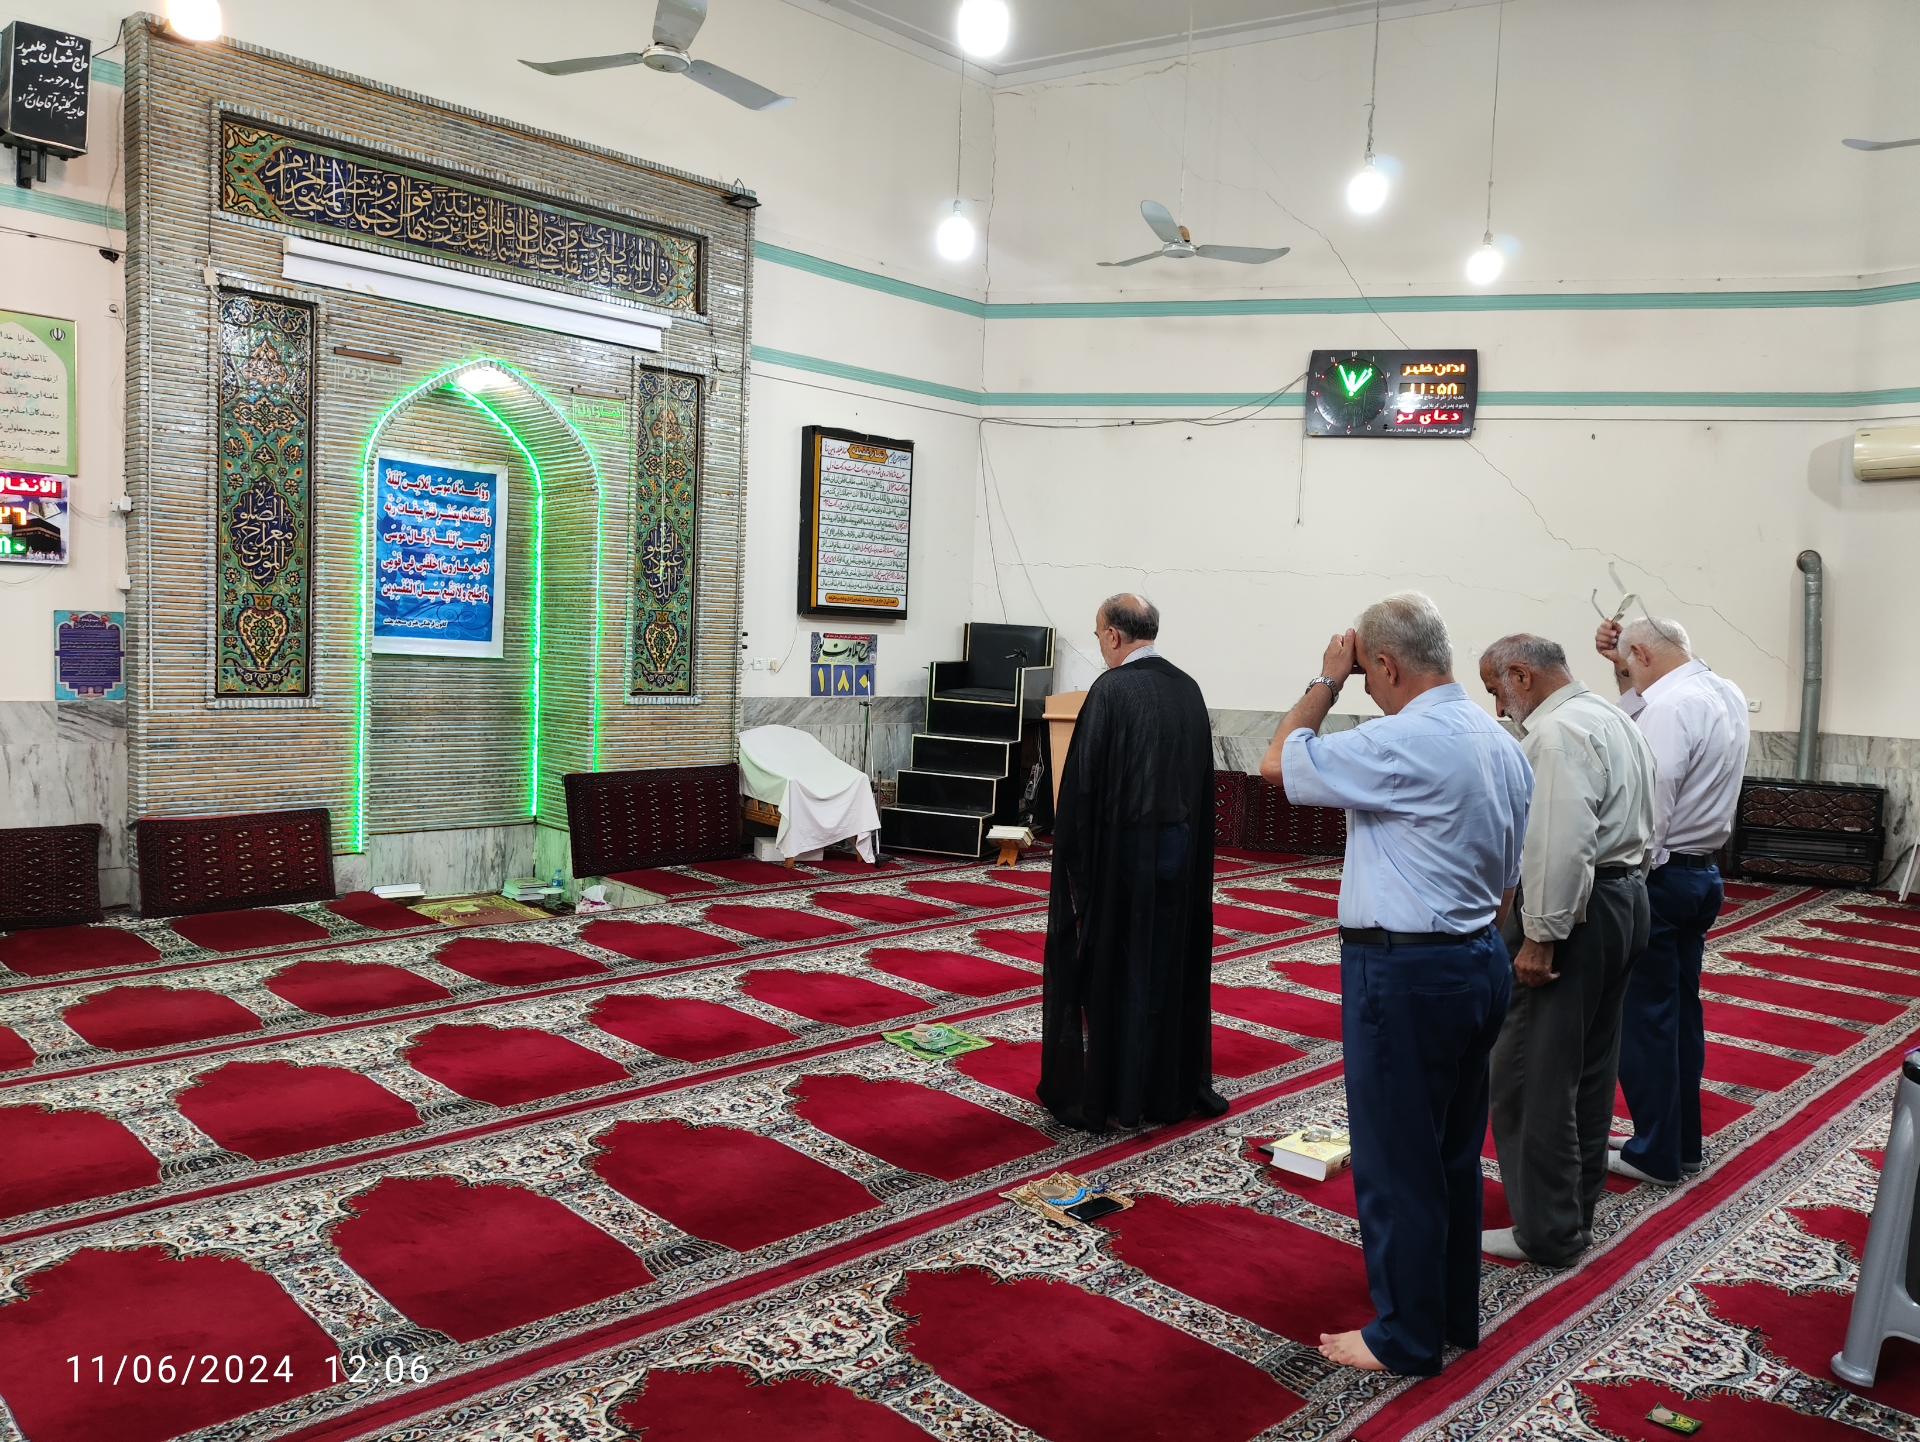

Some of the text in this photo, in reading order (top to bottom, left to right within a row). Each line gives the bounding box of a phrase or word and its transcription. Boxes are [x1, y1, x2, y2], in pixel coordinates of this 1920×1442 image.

[56, 36, 83, 51] واقف
[38, 47, 73, 68] شعبان
[1402, 363, 1434, 376] ظهر
